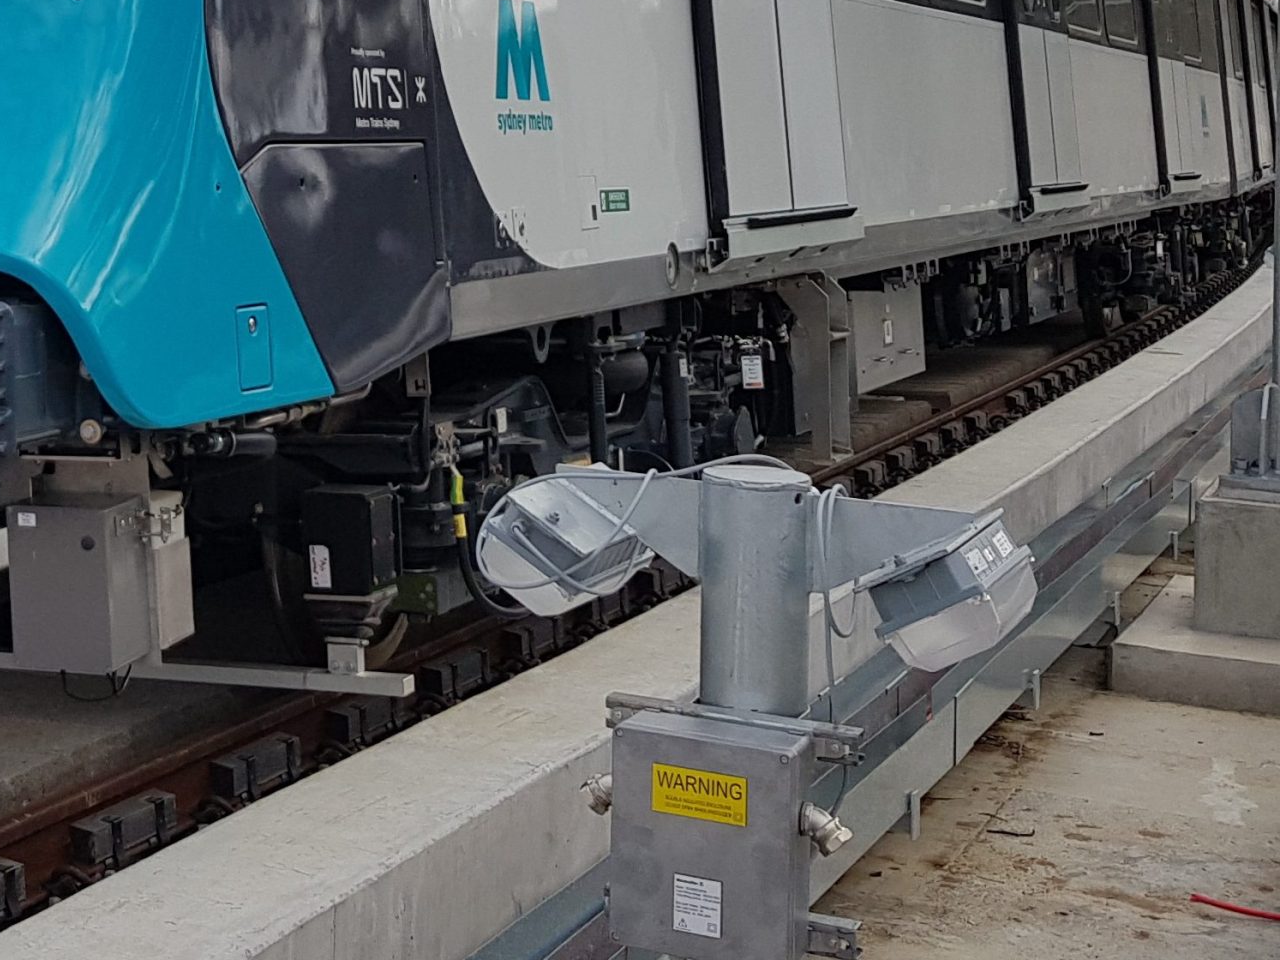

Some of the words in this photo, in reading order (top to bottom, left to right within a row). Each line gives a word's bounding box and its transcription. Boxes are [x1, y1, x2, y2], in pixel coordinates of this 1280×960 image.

[352, 67, 403, 109] MTS
[497, 107, 526, 136] sydney
[528, 110, 553, 131] metro
[657, 770, 743, 801] WARNING
